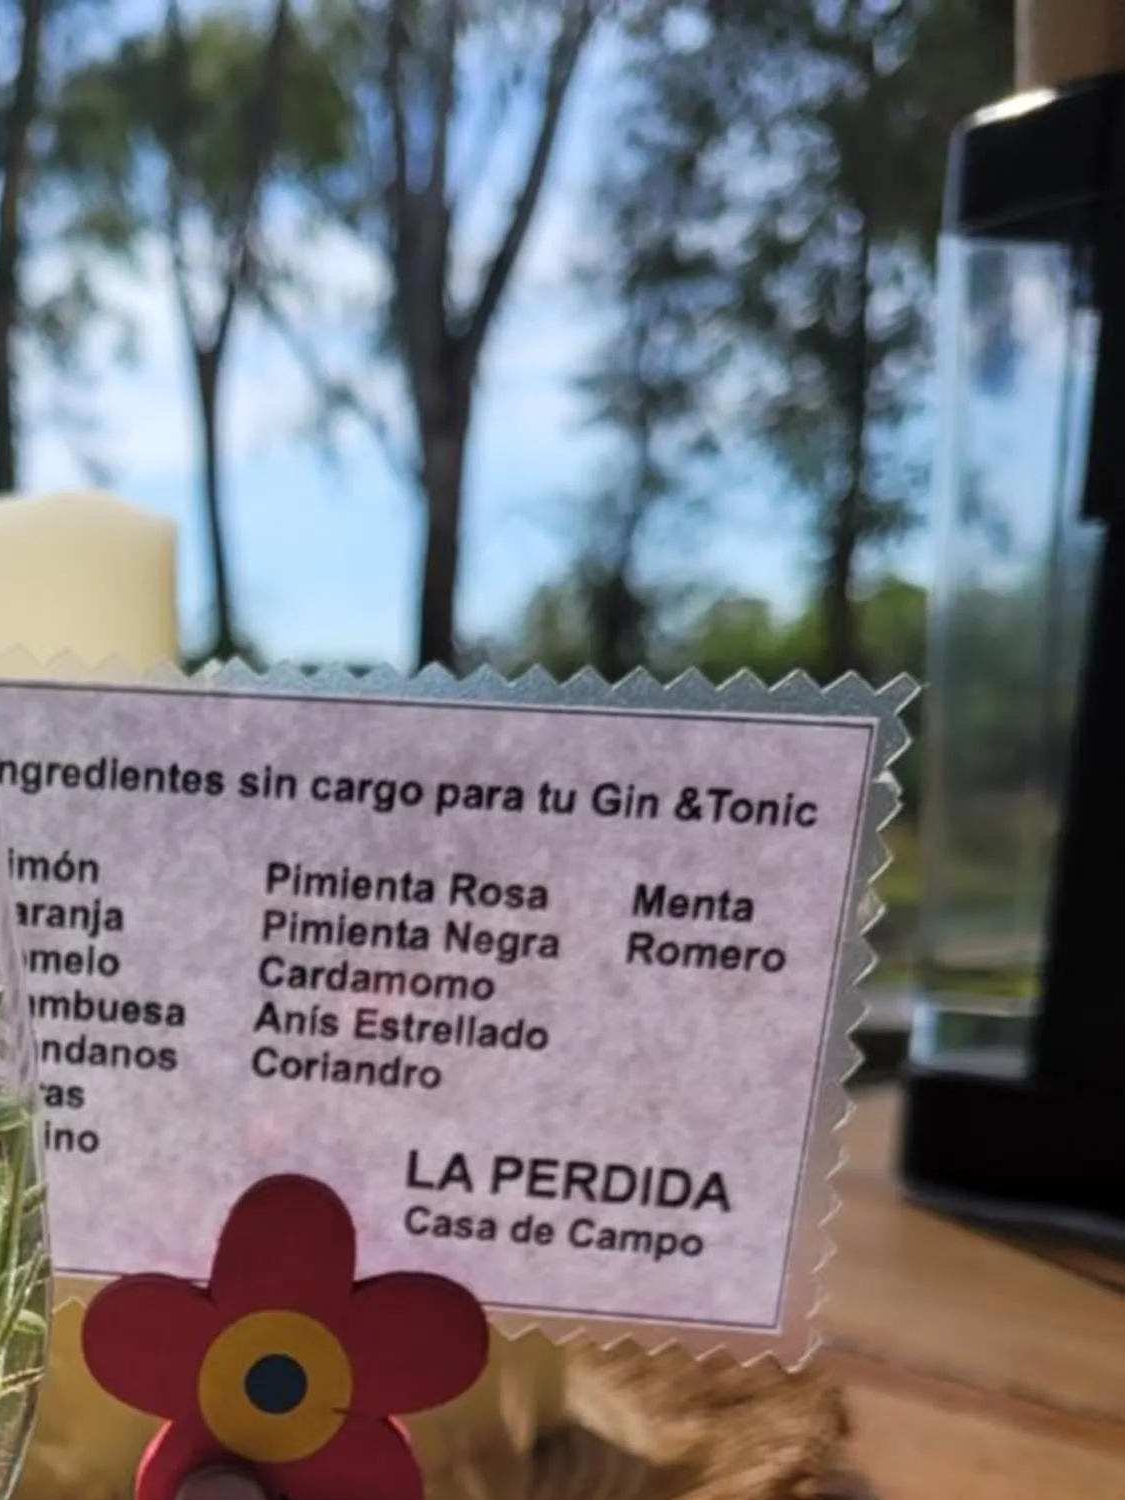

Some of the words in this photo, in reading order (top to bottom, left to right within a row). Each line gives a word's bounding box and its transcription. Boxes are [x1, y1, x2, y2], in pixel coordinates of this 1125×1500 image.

[238, 765, 297, 799] sin
[311, 776, 424, 813] cargo
[435, 782, 525, 816] para
[538, 781, 577, 814] tu
[591, 782, 660, 819] Gin
[674, 786, 818, 828] &Tonic
[8, 847, 99, 883] imón
[266, 861, 435, 904] Pimienta
[449, 872, 548, 910] Rosa
[15, 898, 124, 938] aranja
[632, 883, 754, 922] Menta
[262, 909, 430, 951] Pimienta
[444, 921, 561, 964] Negra
[626, 931, 787, 973] Romero
[25, 945, 121, 977] melo
[258, 954, 495, 1001] Cardamomo
[29, 989, 186, 1027] mbuesa
[253, 1000, 339, 1037] Anís
[354, 1007, 549, 1051] Estrellado
[41, 1034, 178, 1072] ndanos
[251, 1046, 442, 1090] Coriandro
[39, 1084, 85, 1109] as
[44, 1120, 100, 1154] ino
[406, 1149, 473, 1193] LA
[491, 1155, 731, 1212] PERDIDA
[404, 1205, 498, 1241] Casa
[510, 1214, 555, 1246] de
[568, 1217, 704, 1262] Campo
